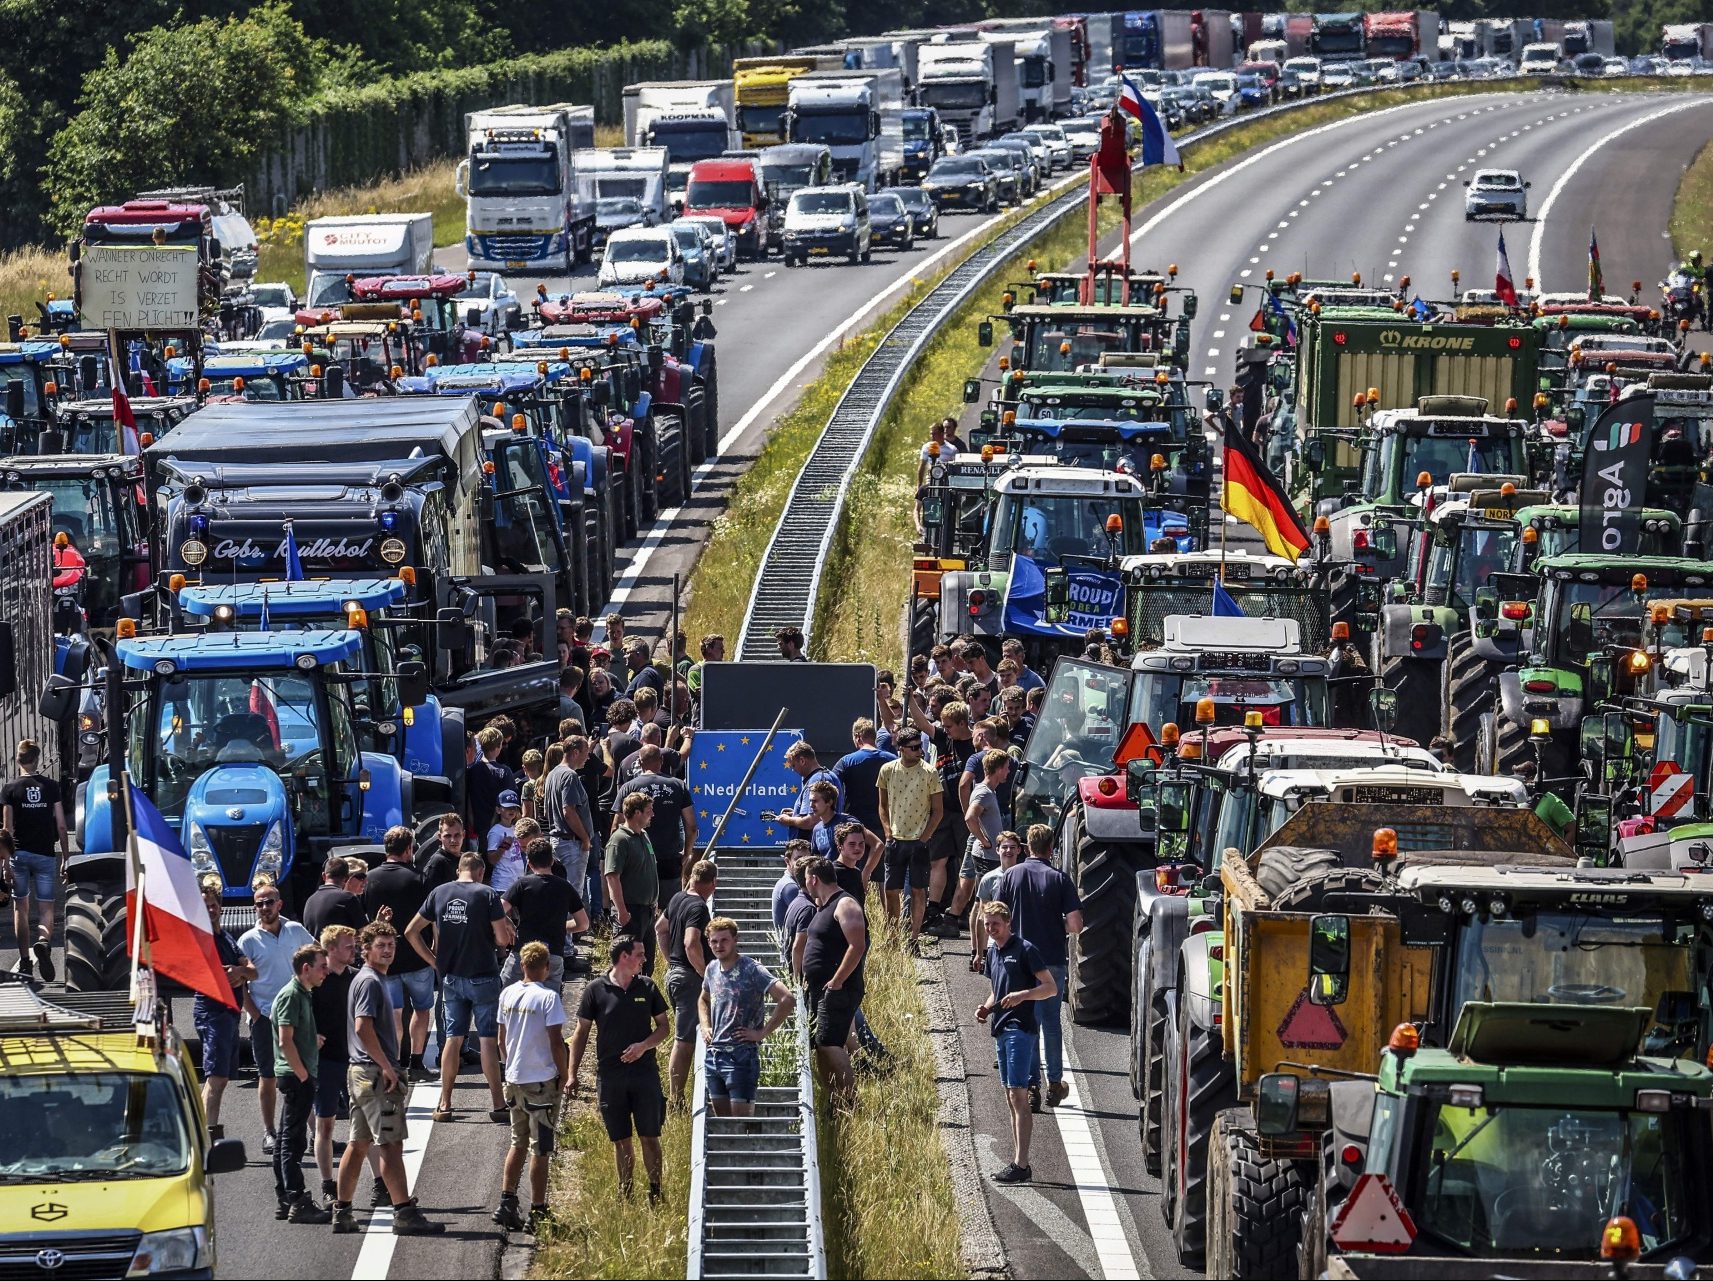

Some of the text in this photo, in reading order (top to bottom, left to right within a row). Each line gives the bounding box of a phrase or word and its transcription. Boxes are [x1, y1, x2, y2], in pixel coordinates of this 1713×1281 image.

[661, 113, 715, 121] KOOPMAN
[87, 251, 186, 263] WANNEER ONRECHT
[95, 270, 178, 284] RECHT WORDT
[110, 290, 178, 306] IS VERZET
[102, 310, 131, 327] EEN
[1401, 335, 1475, 350] KRONE
[1041, 410, 1051, 420] 50
[214, 538, 373, 559] Gebr. Kullebol
[1068, 582, 1112, 604] ROUD
[1570, 893, 1628, 904] CLAAS
